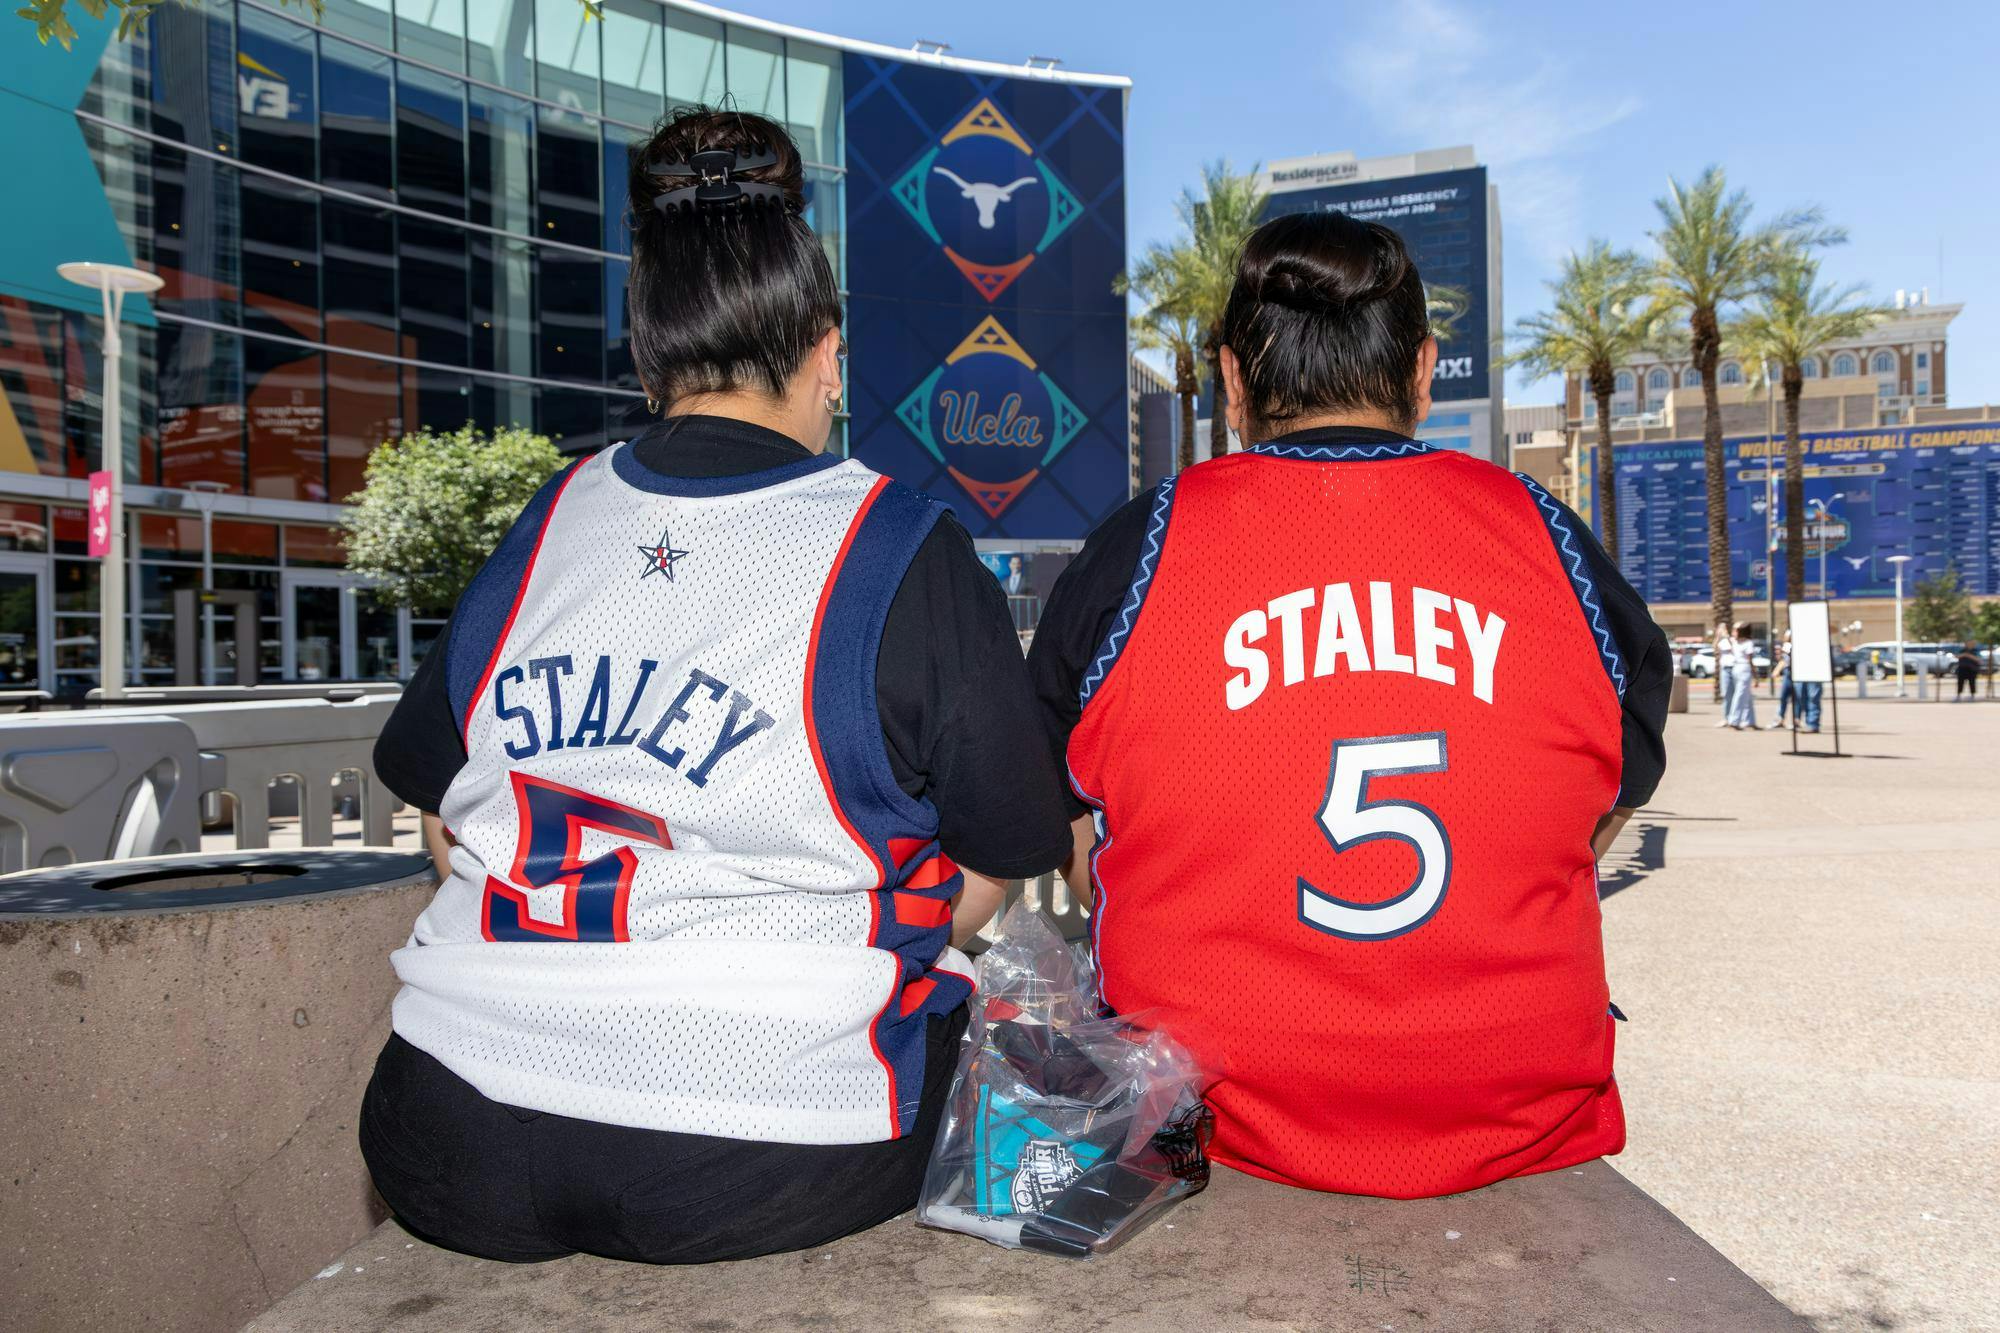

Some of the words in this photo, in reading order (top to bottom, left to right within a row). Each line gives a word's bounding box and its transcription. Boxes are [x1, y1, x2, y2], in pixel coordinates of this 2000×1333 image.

[1273, 164, 1338, 183] Residence
[1350, 197, 1390, 211] VEGAS
[1391, 188, 1458, 206] RESIDENCY
[940, 390, 1043, 447] Ucla
[1738, 440, 1810, 458] WOMES
[1811, 434, 1906, 455] BASKETBALL
[1224, 581, 1507, 710] STALEY
[495, 655, 776, 789] STALEY
[481, 770, 674, 943] 5
[1297, 730, 1453, 942] 5
[1035, 1148, 1061, 1194] FOUR
